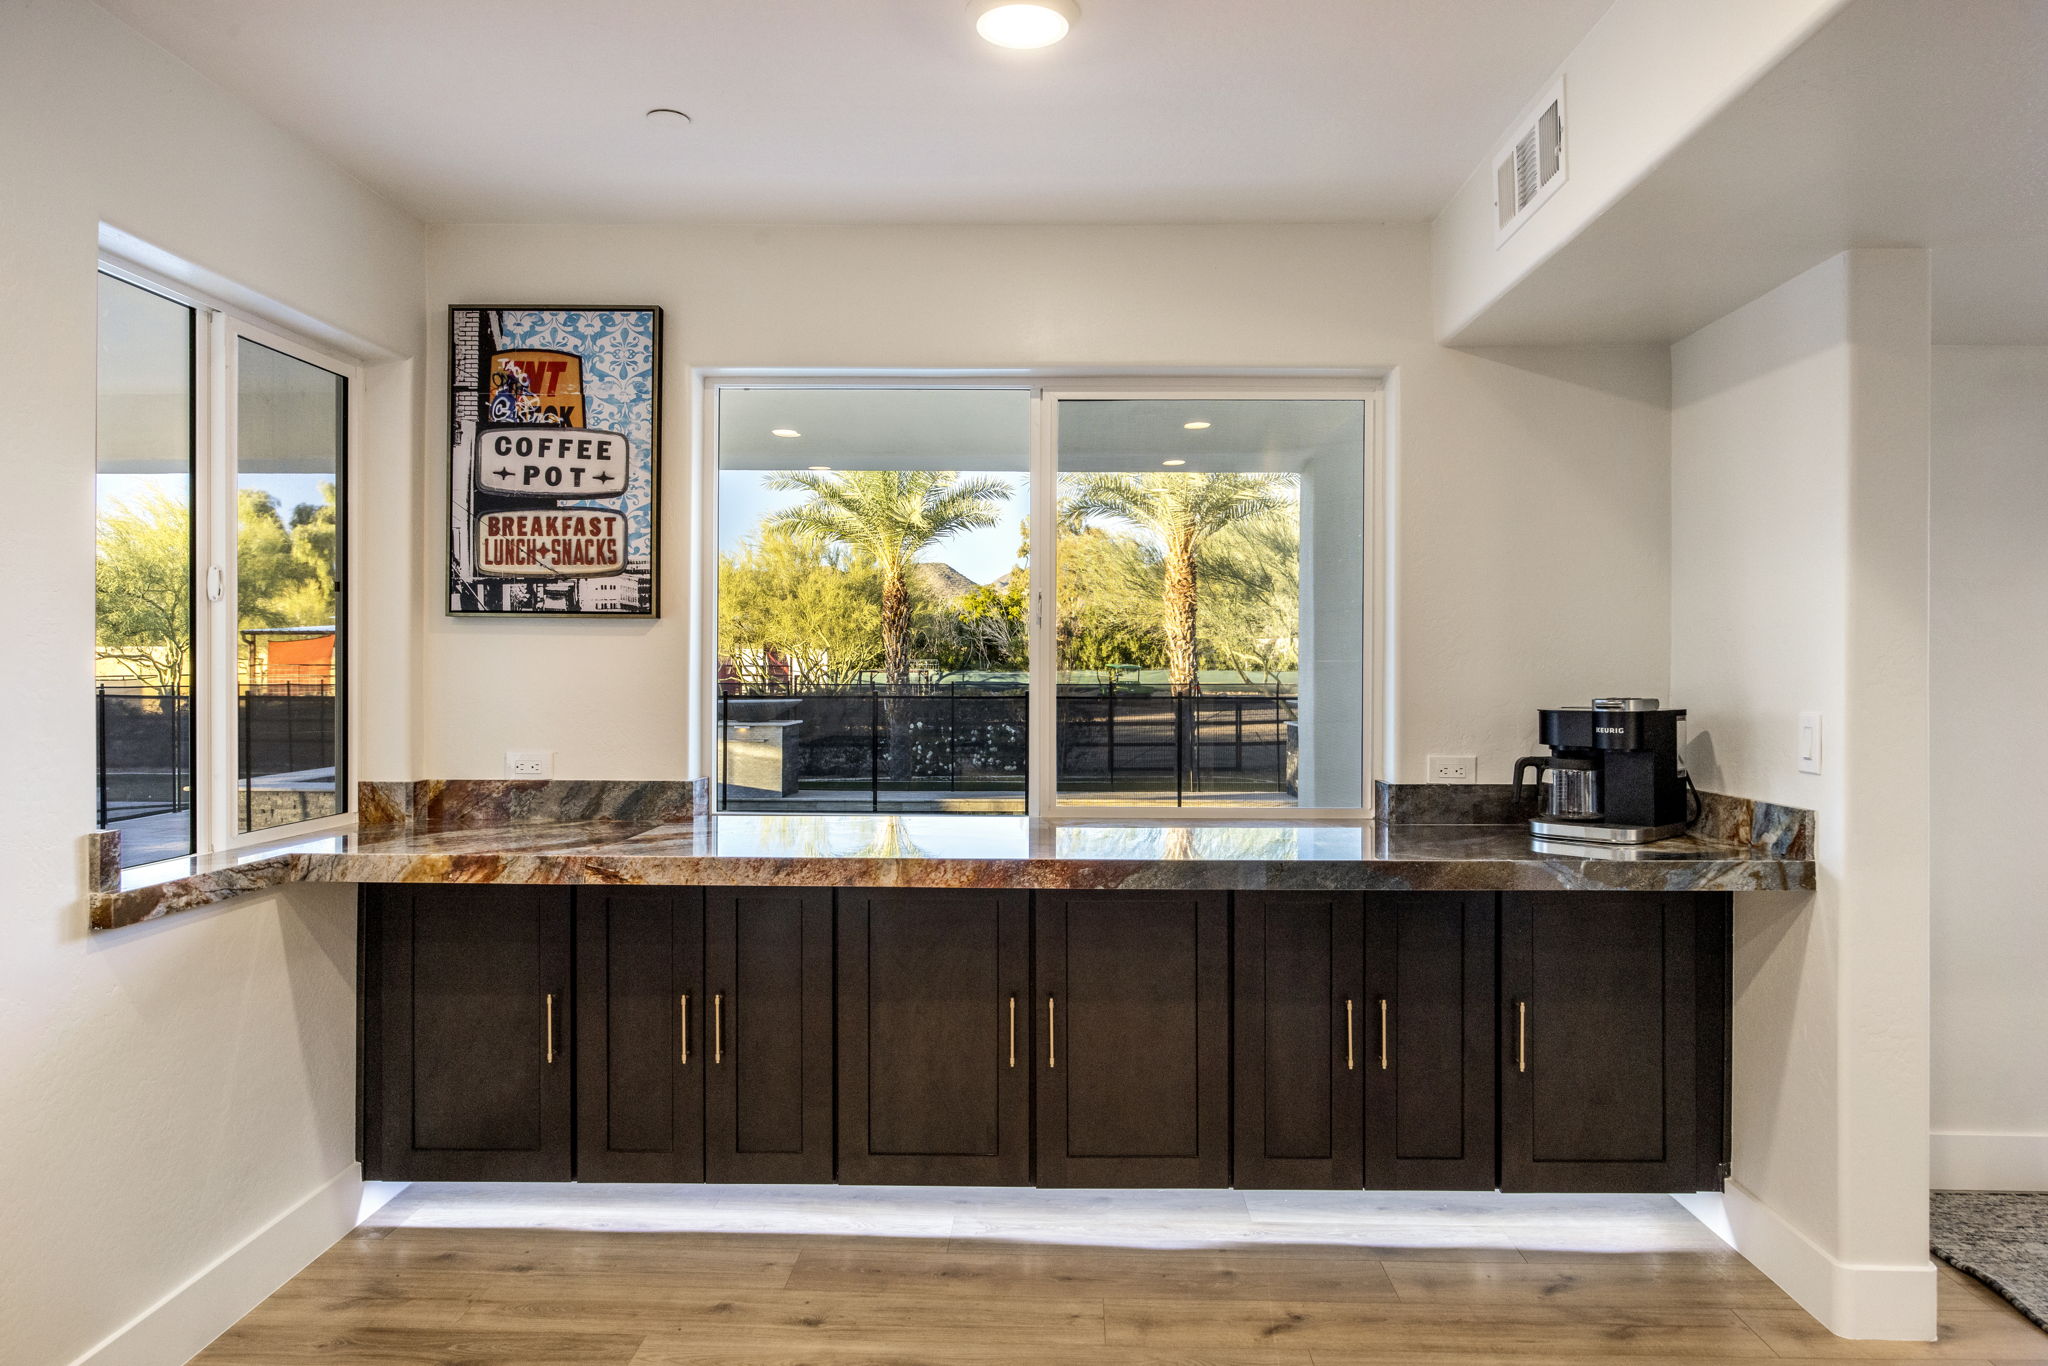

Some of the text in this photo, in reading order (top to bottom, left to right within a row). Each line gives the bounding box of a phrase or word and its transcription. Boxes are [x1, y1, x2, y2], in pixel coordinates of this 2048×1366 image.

[494, 435, 612, 461] COFFEE
[523, 465, 586, 488] POT
[487, 516, 617, 537] BREAKFAST
[484, 538, 618, 566] LUNCH SNACKS
[1595, 726, 1625, 734] KEURIG
